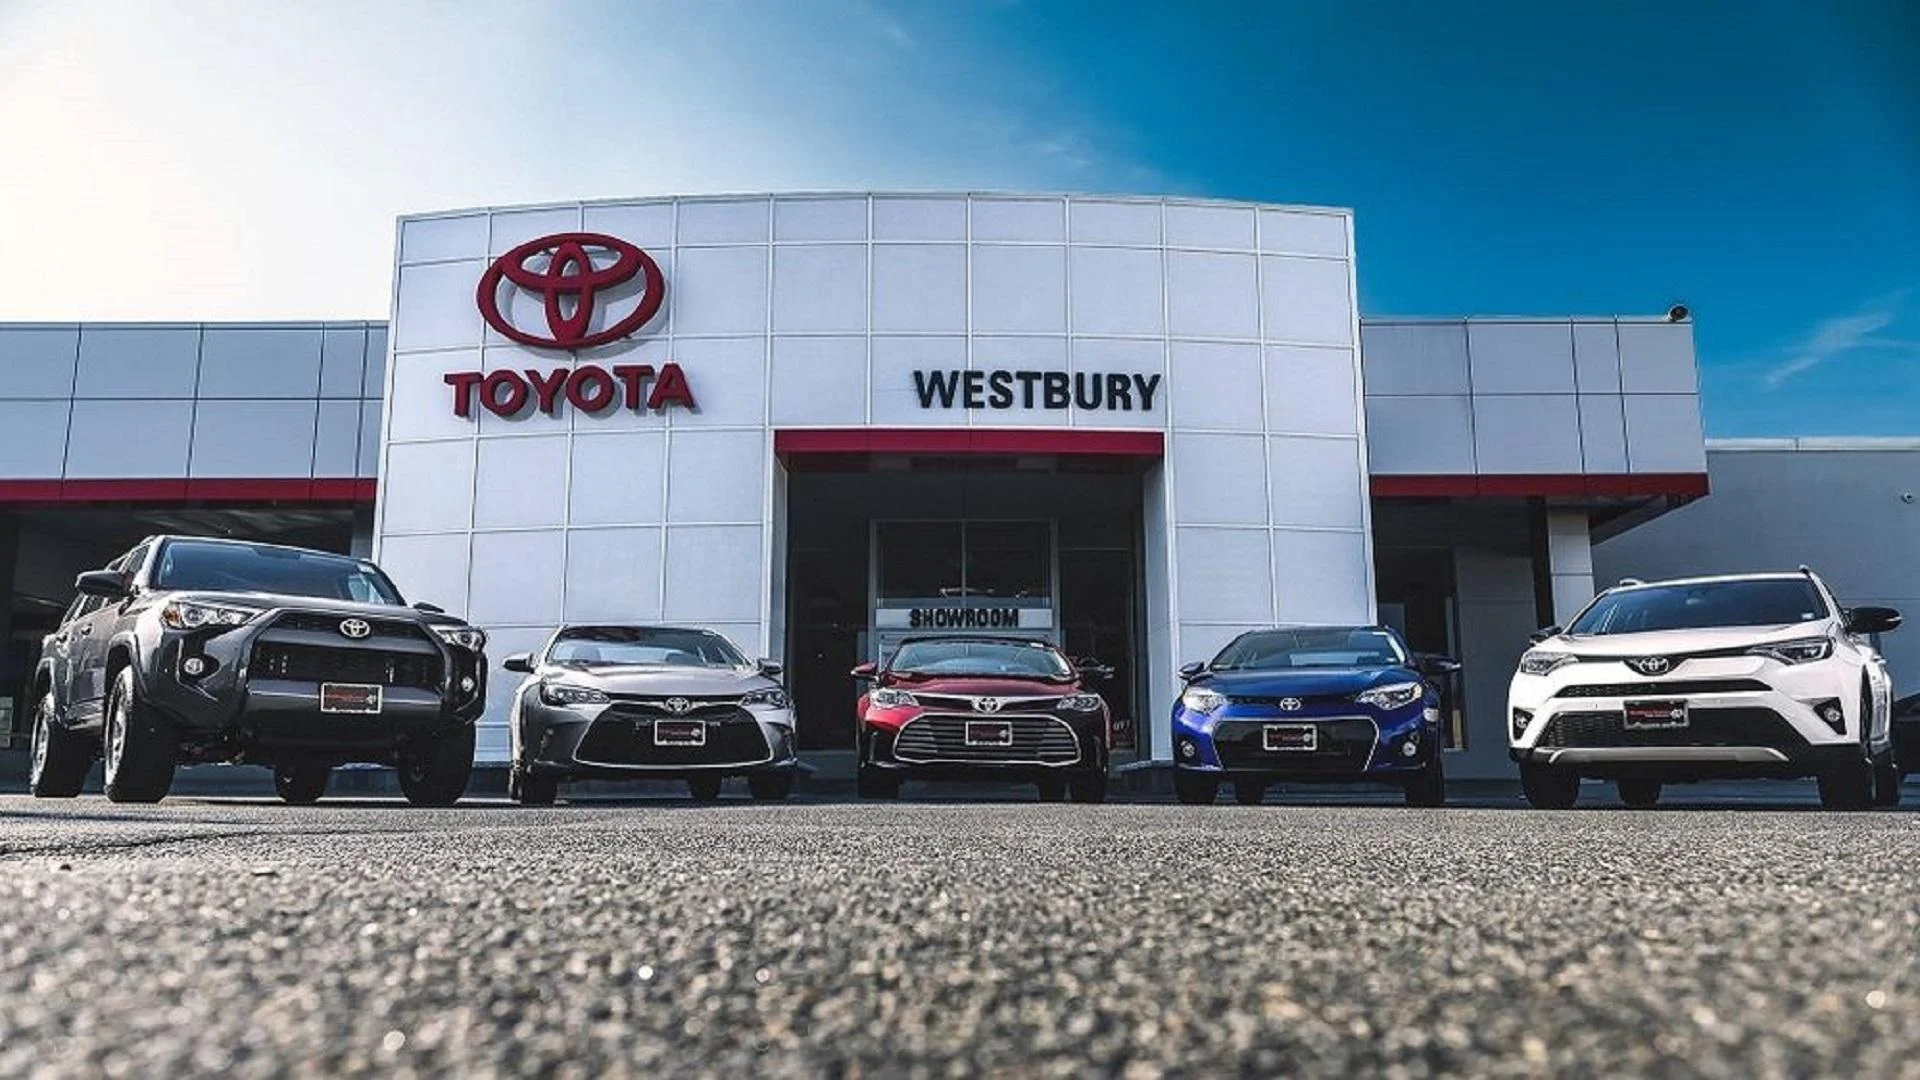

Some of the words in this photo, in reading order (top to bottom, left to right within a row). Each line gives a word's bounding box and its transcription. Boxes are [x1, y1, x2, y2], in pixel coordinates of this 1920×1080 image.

[444, 363, 695, 418] TOYOTA
[913, 370, 1161, 411] WESTBURY
[910, 608, 1019, 627] SHOWROOM
